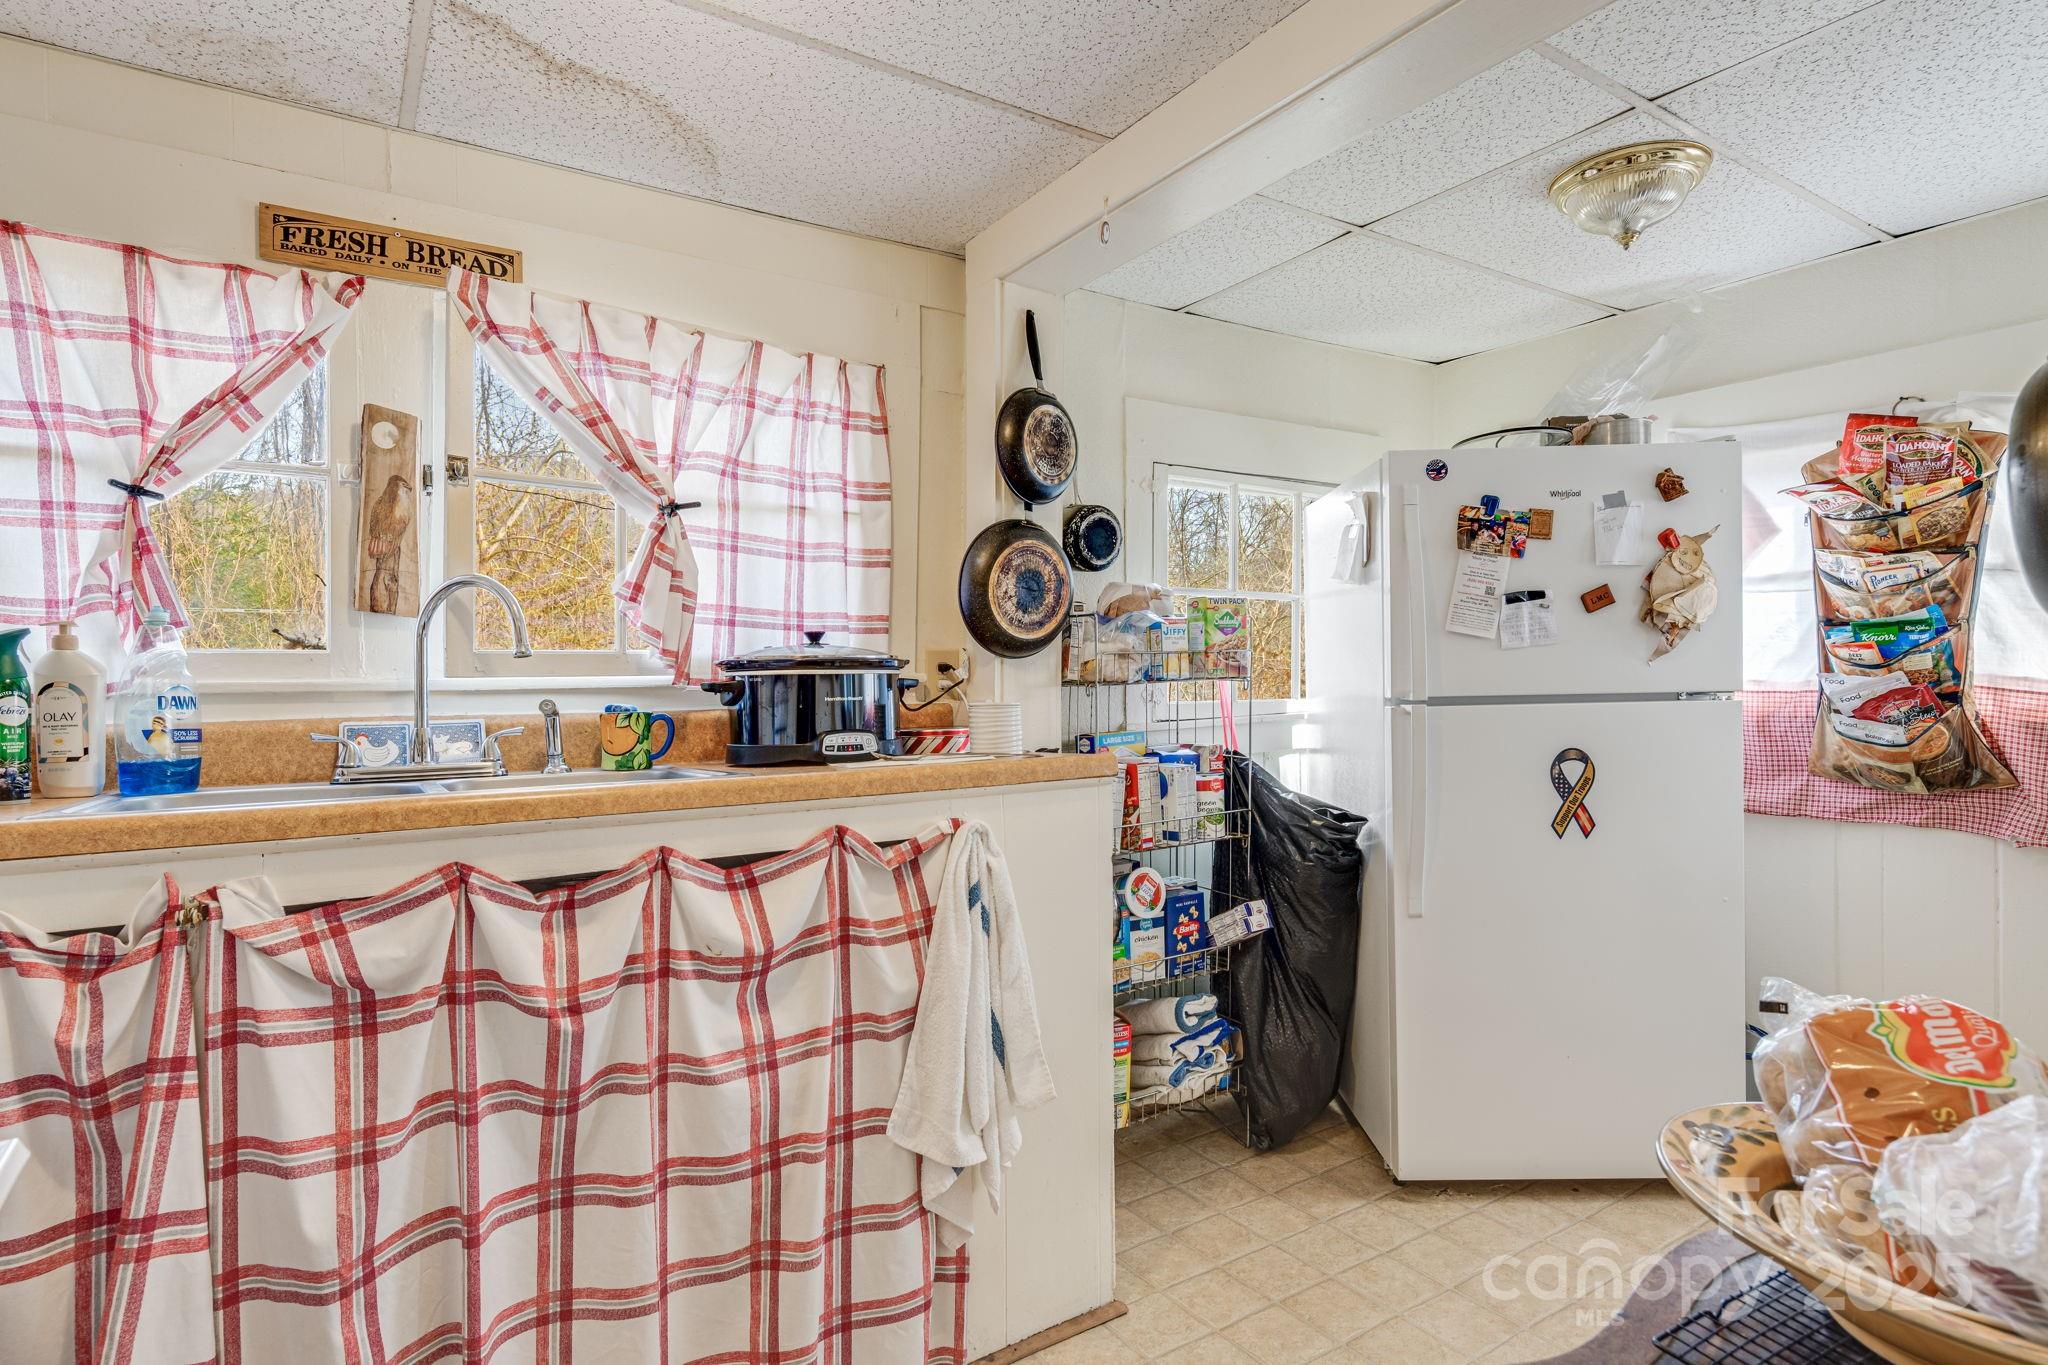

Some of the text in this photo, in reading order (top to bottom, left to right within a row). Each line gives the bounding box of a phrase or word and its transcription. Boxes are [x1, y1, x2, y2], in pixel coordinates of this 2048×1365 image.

[280, 226, 508, 278] FRESH BREAD
[280, 242, 442, 276] BAKED DAILY ON THE
[1895, 440, 1947, 453] IDAHOAN
[1549, 489, 1582, 499] Whirlpool
[1163, 626, 1187, 636] JIFFY
[1860, 632, 1897, 642] Knorr
[1824, 677, 1845, 685] Food
[157, 695, 198, 711] DAWN
[1840, 692, 1862, 704] Food
[43, 712, 77, 722] OLAY
[1555, 805, 1574, 827] Support
[1575, 776, 1592, 797] Troops
[1179, 924, 1198, 934] Barilla
